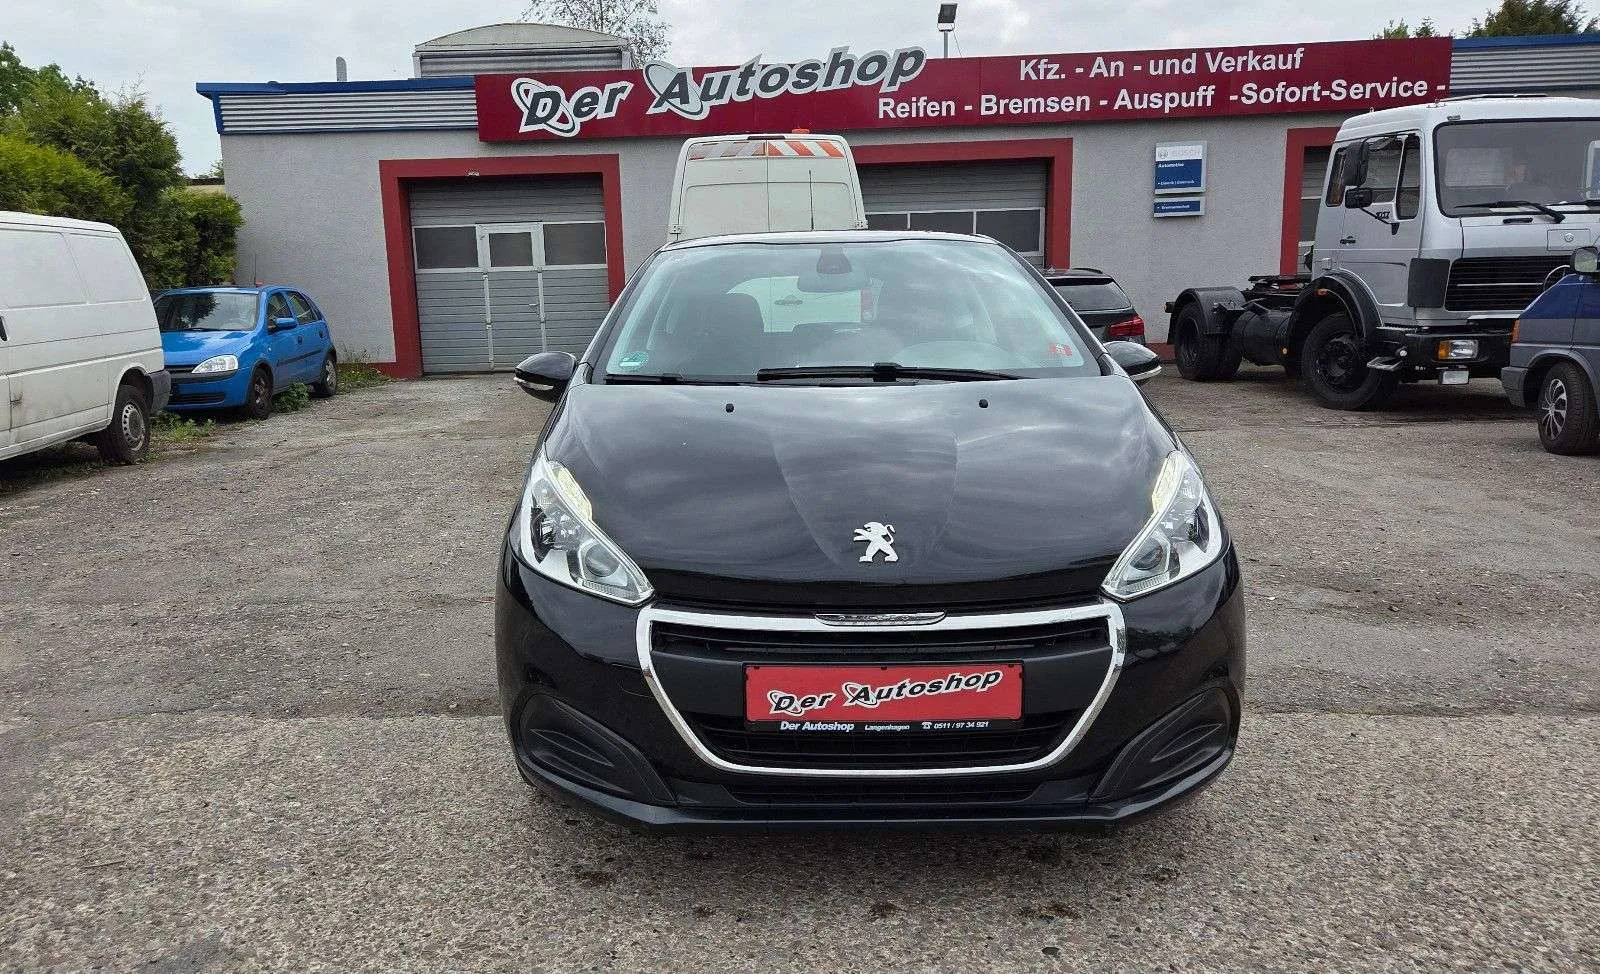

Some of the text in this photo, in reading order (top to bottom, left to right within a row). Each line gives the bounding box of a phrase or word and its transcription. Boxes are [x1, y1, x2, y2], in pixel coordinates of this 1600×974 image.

[1020, 58, 1066, 81] Kfz.
[1089, 57, 1124, 78] An
[1150, 53, 1197, 76] und
[1205, 48, 1305, 73] Verkauf
[514, 47, 926, 135] Der Autoshop
[878, 97, 955, 118] Reifen
[980, 94, 1090, 116] Bremsen
[1113, 85, 1216, 113] Auspuff
[770, 670, 1003, 715] Der Autoshop
[780, 720, 800, 731] Der
[802, 721, 855, 732] Autoshop
[864, 724, 910, 732] Langenhagen
